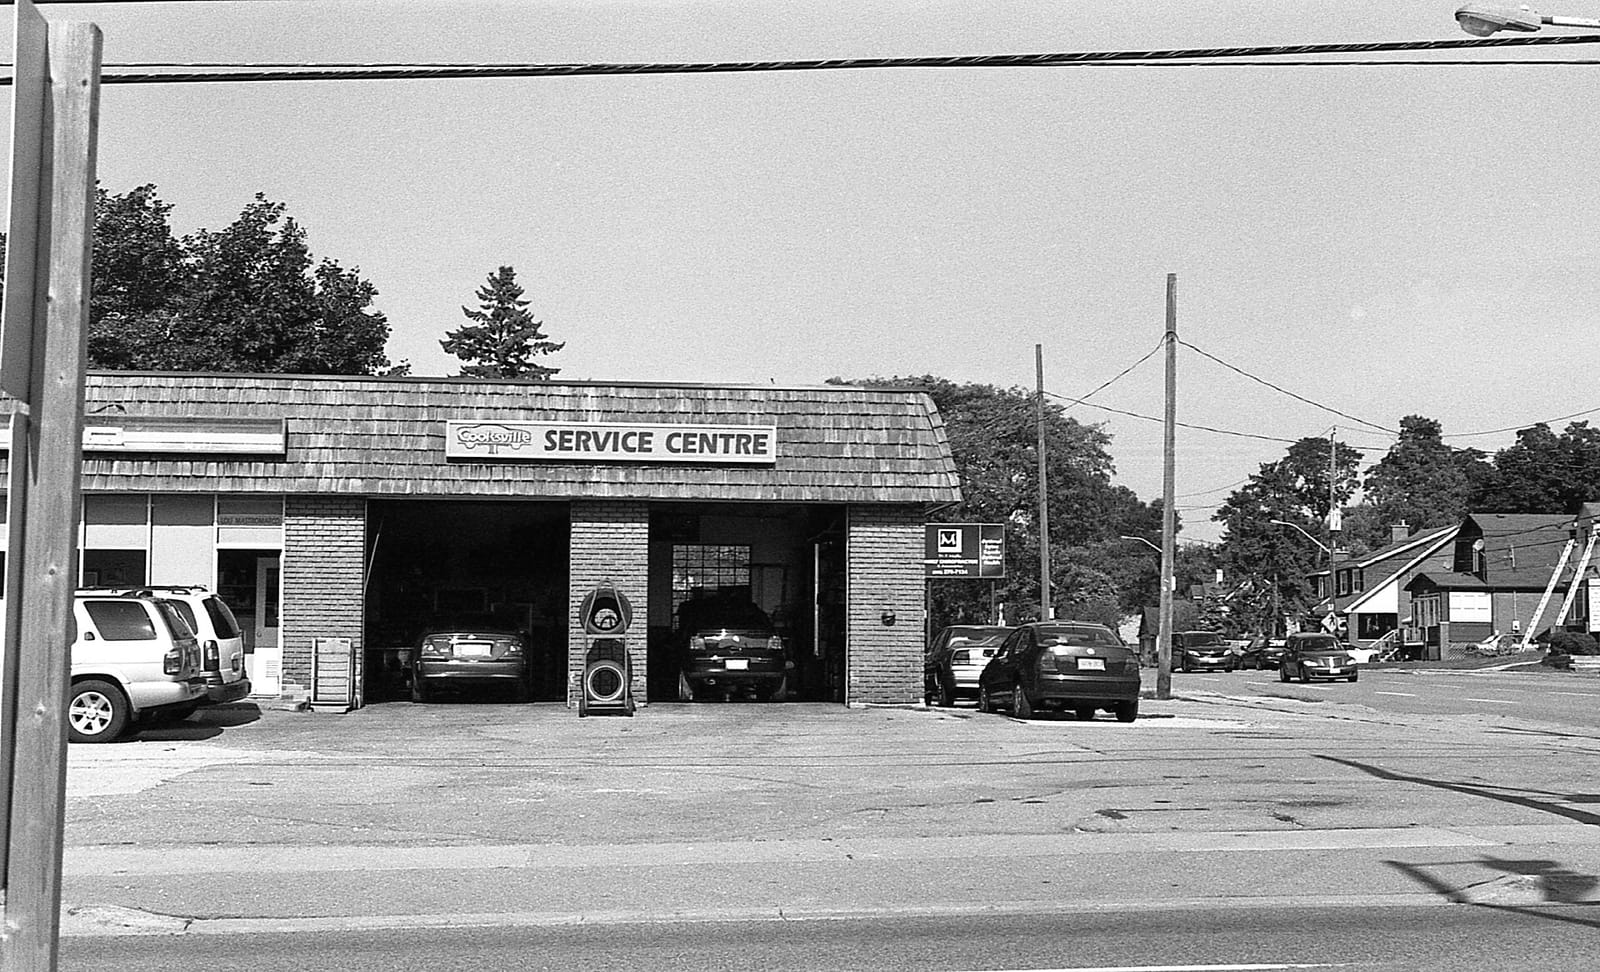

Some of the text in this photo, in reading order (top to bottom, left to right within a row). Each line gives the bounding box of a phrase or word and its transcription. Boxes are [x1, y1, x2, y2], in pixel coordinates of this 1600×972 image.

[458, 429, 769, 455] Cooksville SERVICE CENTRE
